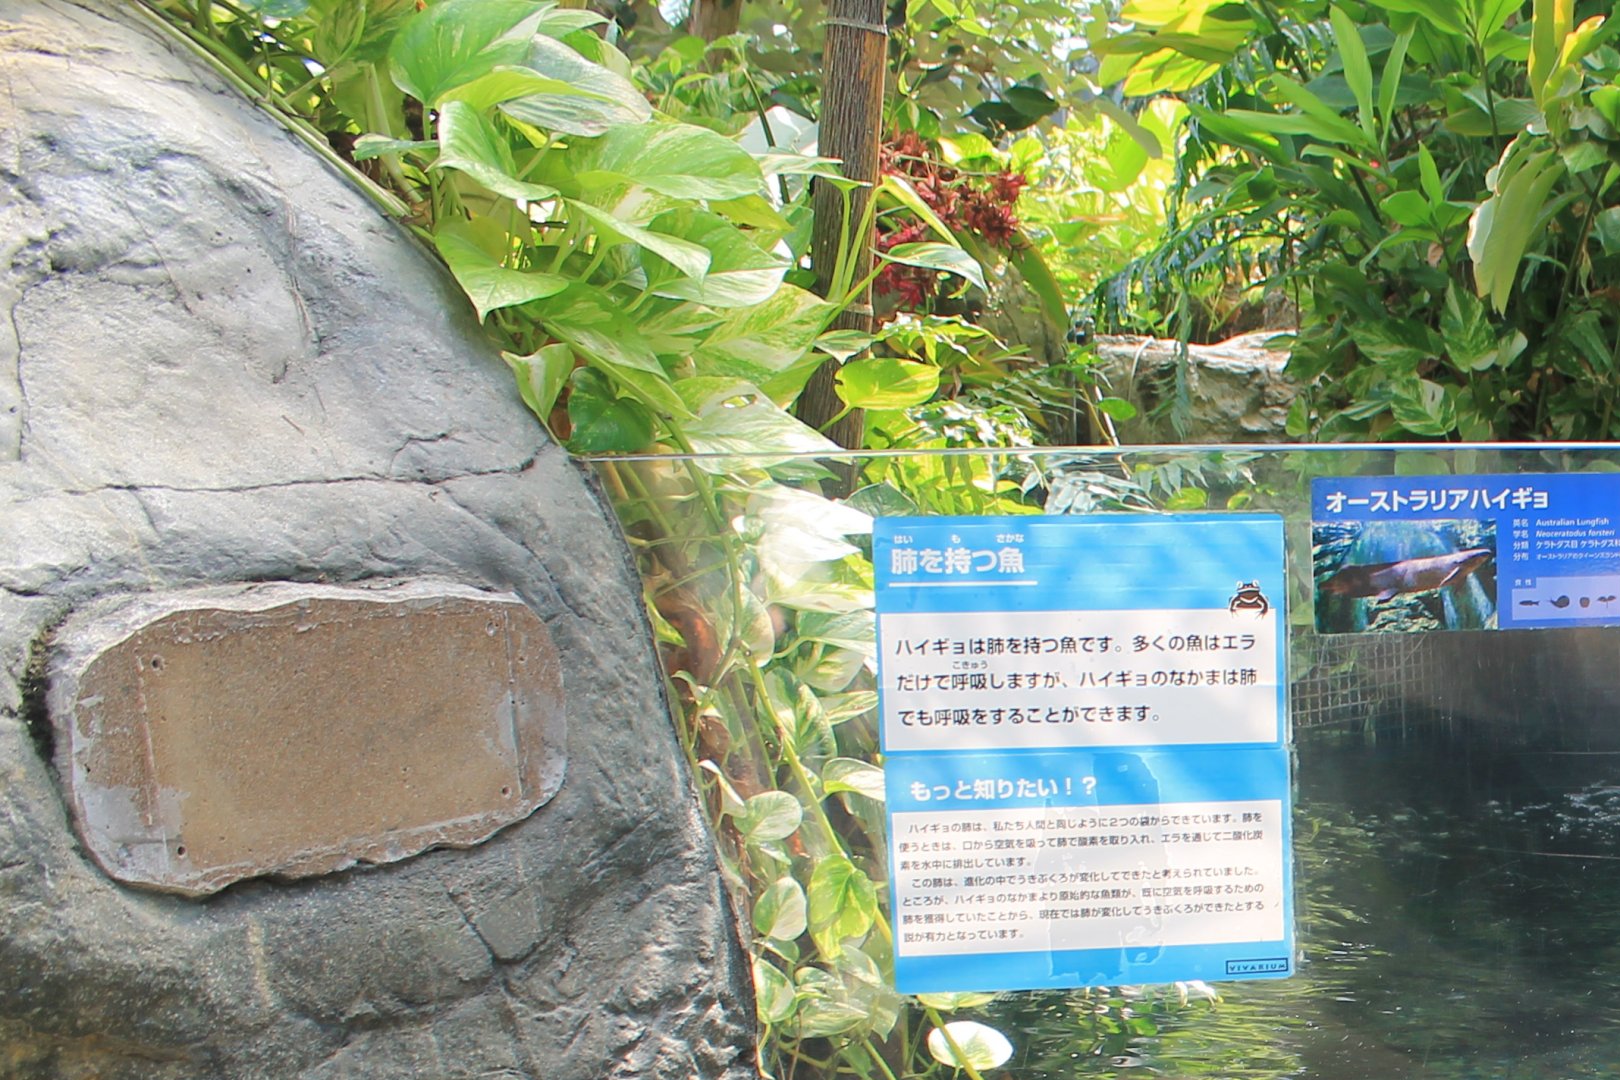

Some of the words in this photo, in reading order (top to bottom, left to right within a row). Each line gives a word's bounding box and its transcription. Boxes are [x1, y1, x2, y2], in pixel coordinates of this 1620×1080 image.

[1325, 486, 1549, 513] オーストラリアハイギョ
[1536, 518, 1576, 527] Australian
[1577, 517, 1610, 528] Lungfish
[893, 534, 913, 543] はい
[996, 533, 1025, 543] さかな
[1536, 529, 1587, 538] Neoceratodus
[1588, 529, 1616, 537] forsteri
[891, 547, 1025, 576] 肺を持つ魚
[895, 633, 1256, 655] ハイギョは肺を持つ魚です。多くの魚はエラ
[952, 660, 989, 670] こきゅう
[896, 668, 1258, 690] だけで呼吸しますが、ハイギョのなかまは肺
[897, 704, 1161, 726] でも呼吸をすることができます。
[900, 856, 1032, 871] 素を水中に排出しています。
[904, 928, 1025, 943] 説が有力となっています。
[1229, 963, 1287, 973] VIVARIUM
